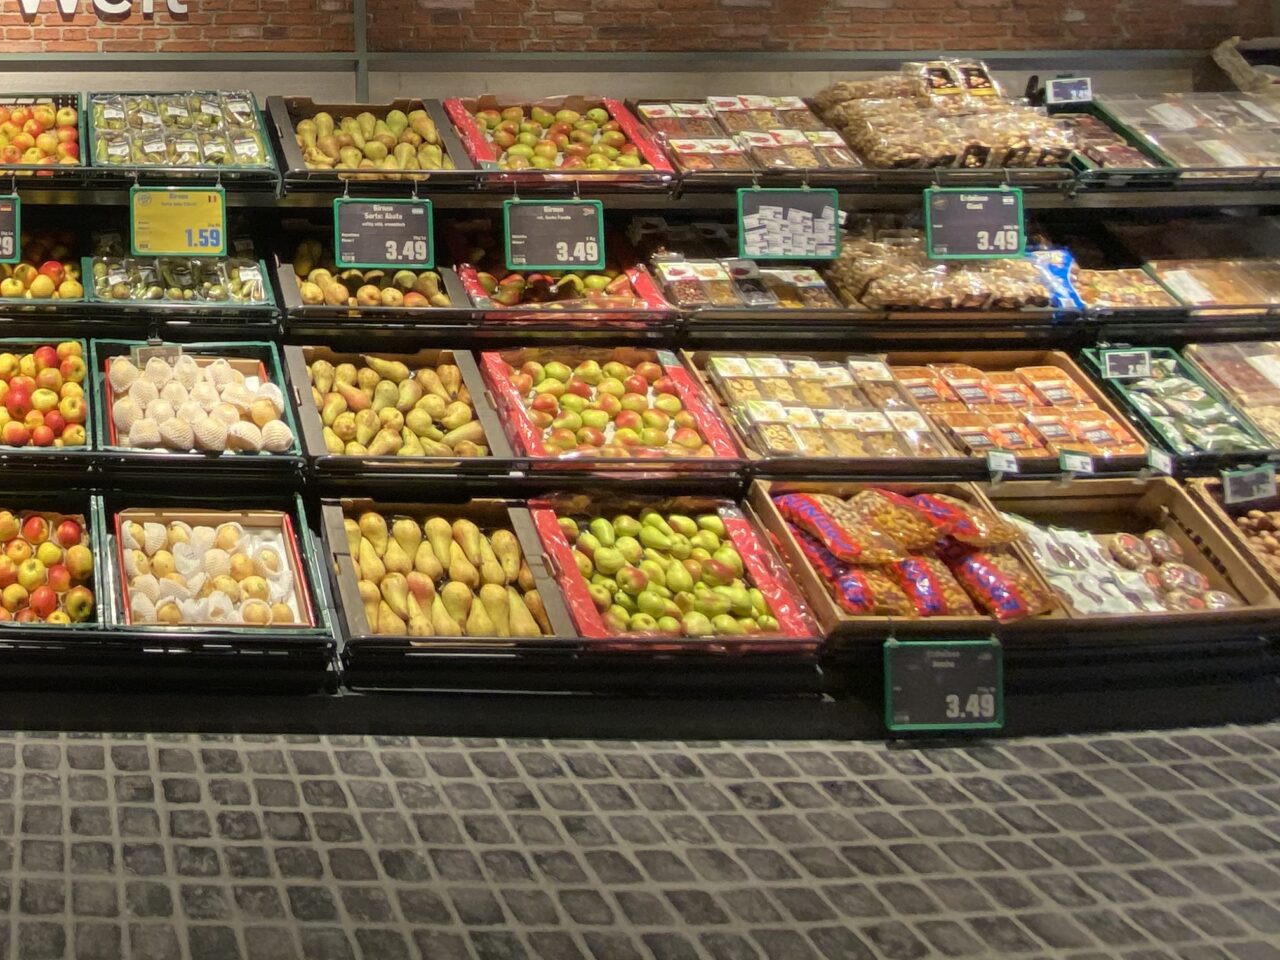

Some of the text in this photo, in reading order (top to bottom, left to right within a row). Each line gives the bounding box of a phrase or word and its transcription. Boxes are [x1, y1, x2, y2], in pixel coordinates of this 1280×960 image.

[185, 229, 220, 247] 1.59
[977, 231, 1018, 250] 3.49
[385, 240, 427, 260] 3.49
[556, 242, 598, 261] 3.49
[945, 694, 995, 718] 3.49
